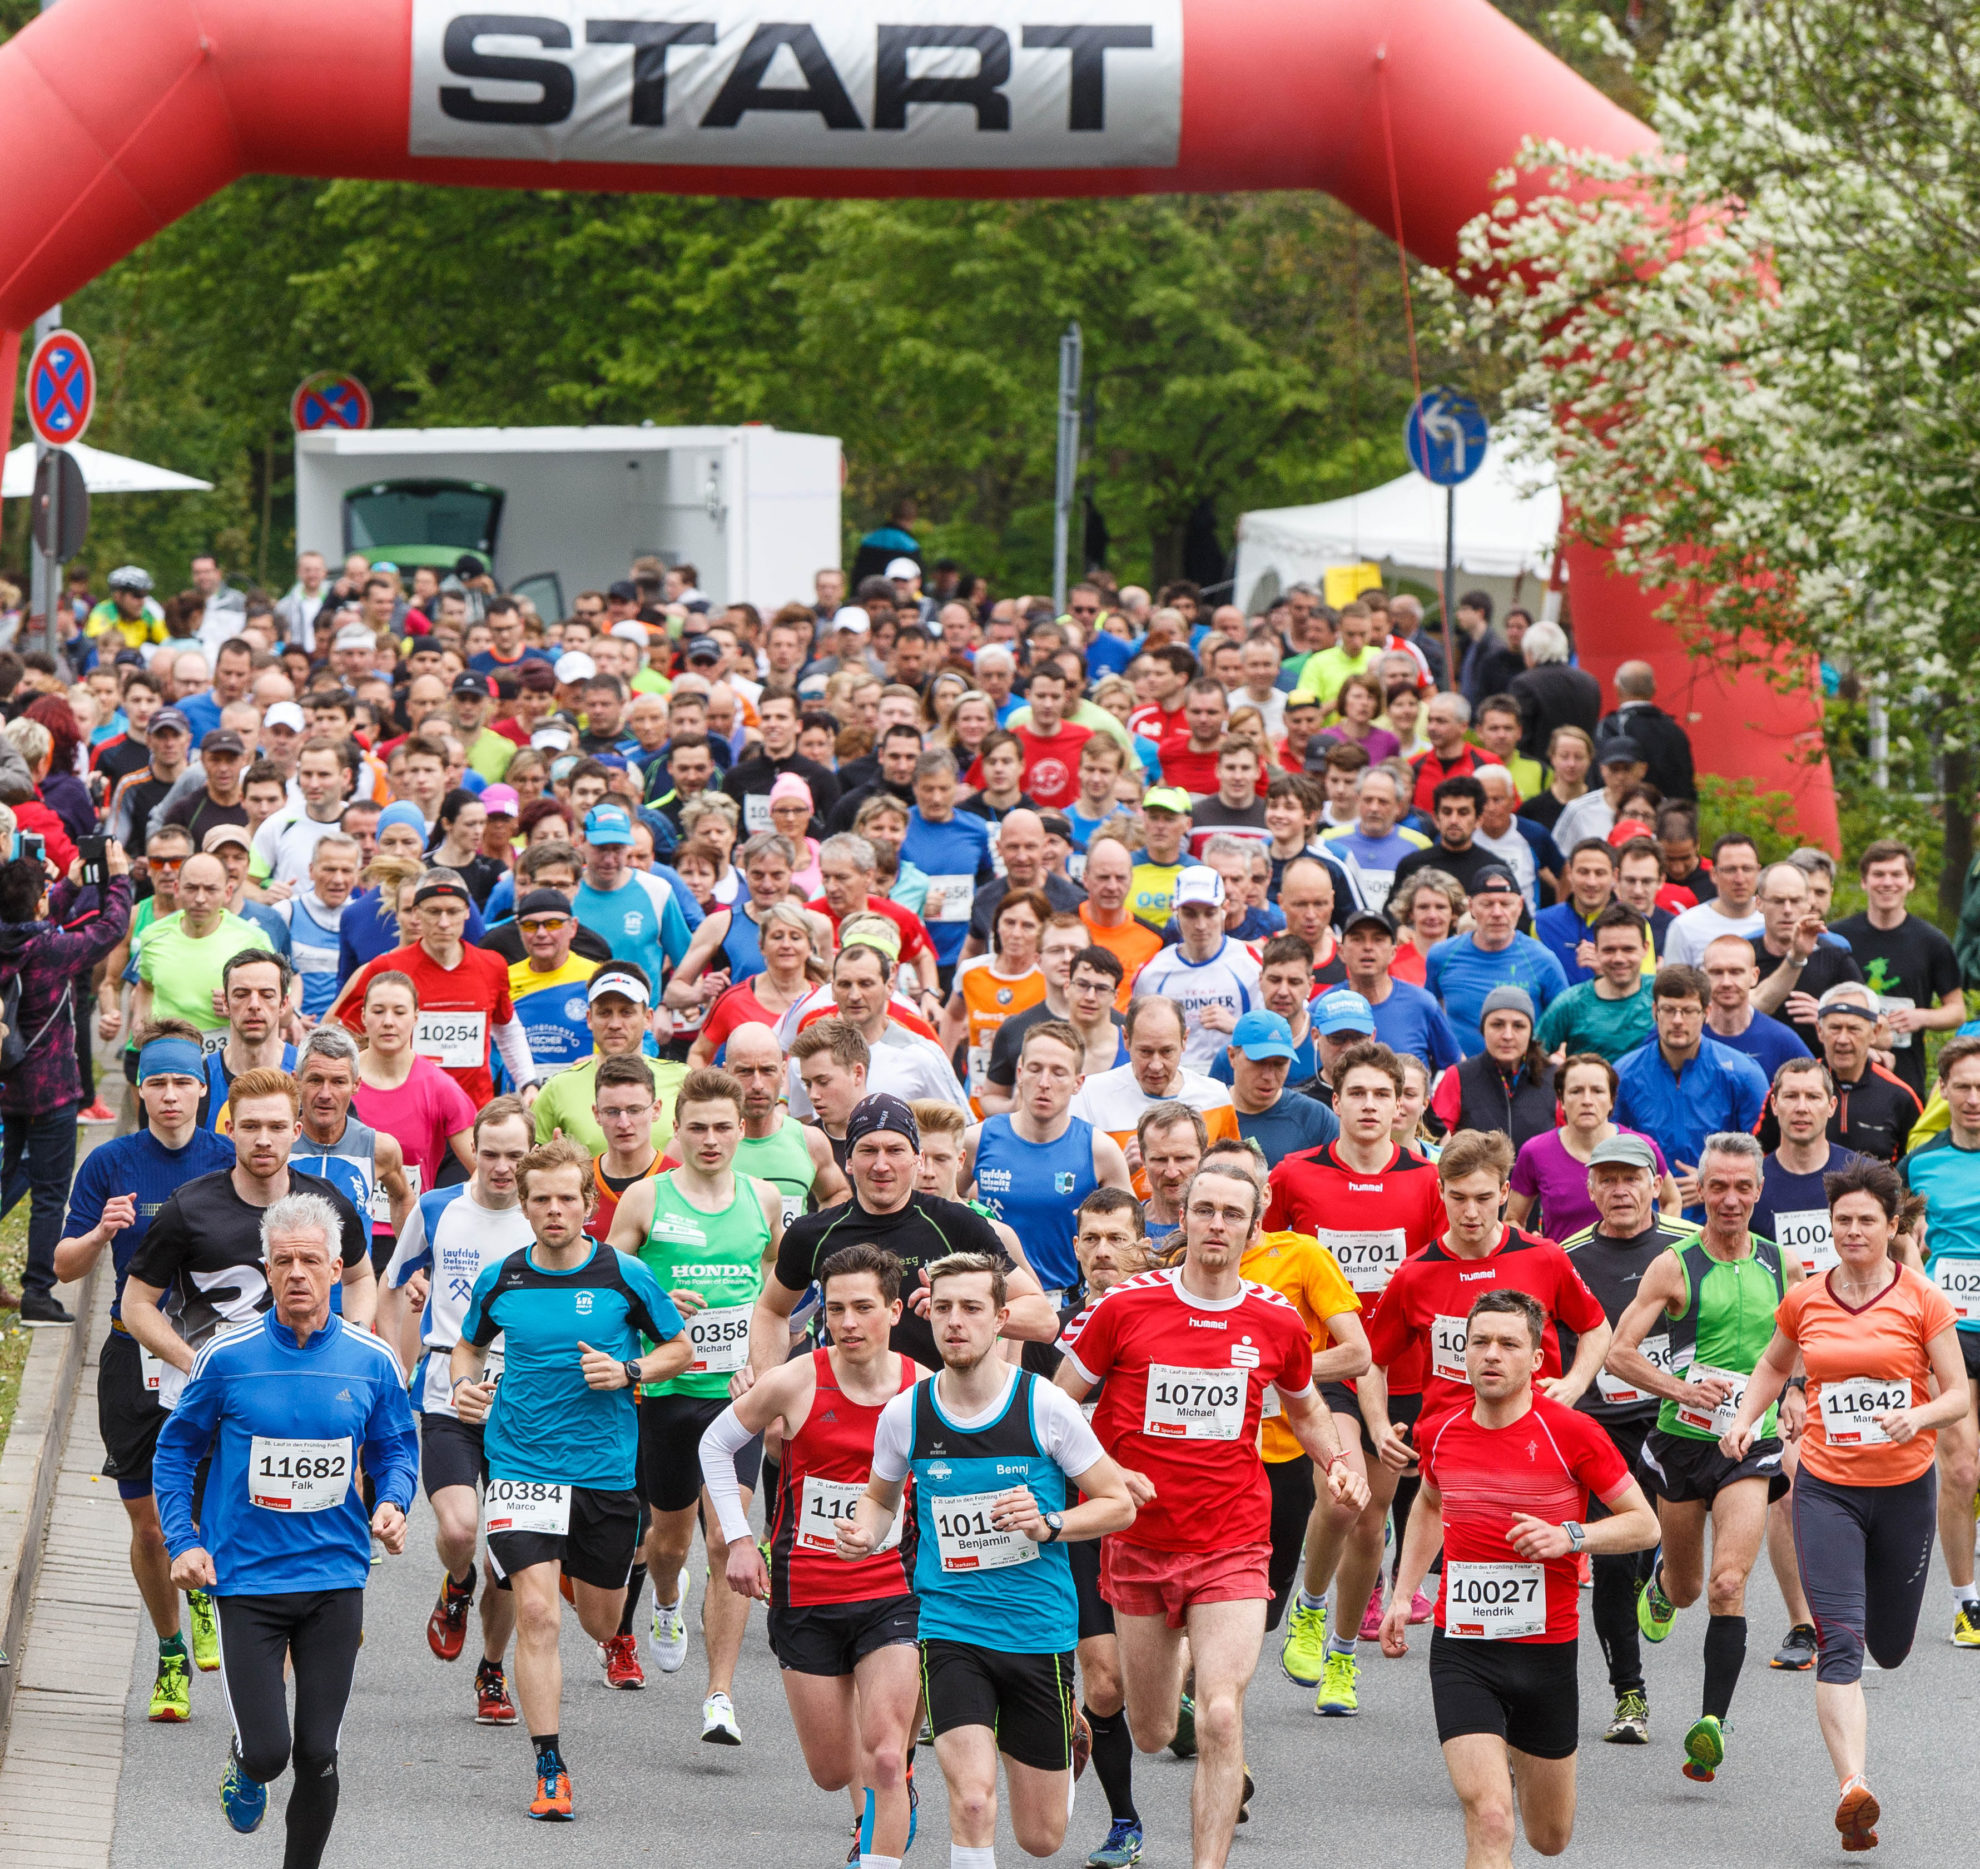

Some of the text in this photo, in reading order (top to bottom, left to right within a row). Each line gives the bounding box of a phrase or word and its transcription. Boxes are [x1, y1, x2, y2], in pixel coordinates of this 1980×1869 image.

[439, 14, 1153, 132] START
[419, 1025, 479, 1041] 10254
[1349, 1181, 1384, 1193] hummel
[443, 1248, 480, 1260] Laufclub
[443, 1257, 480, 1267] Oelsnitz
[671, 1264, 755, 1278] HONDA
[1343, 1265, 1378, 1274] Richard
[1459, 1269, 1496, 1283] hummel
[1188, 1317, 1228, 1330] hummel
[696, 1344, 732, 1354] Richard
[1155, 1382, 1239, 1407] 10703
[1827, 1389, 1906, 1415] 11642
[1176, 1407, 1216, 1417] Michael
[259, 1456, 346, 1479] 11682
[291, 1480, 314, 1490] Falk
[488, 1481, 563, 1504] 10384
[506, 1502, 536, 1511] Marco
[957, 1534, 1011, 1550] Benjamin
[954, 1561, 977, 1569] Sparkasse
[1452, 1578, 1539, 1604] 10027
[1472, 1606, 1515, 1617] Hendrik
